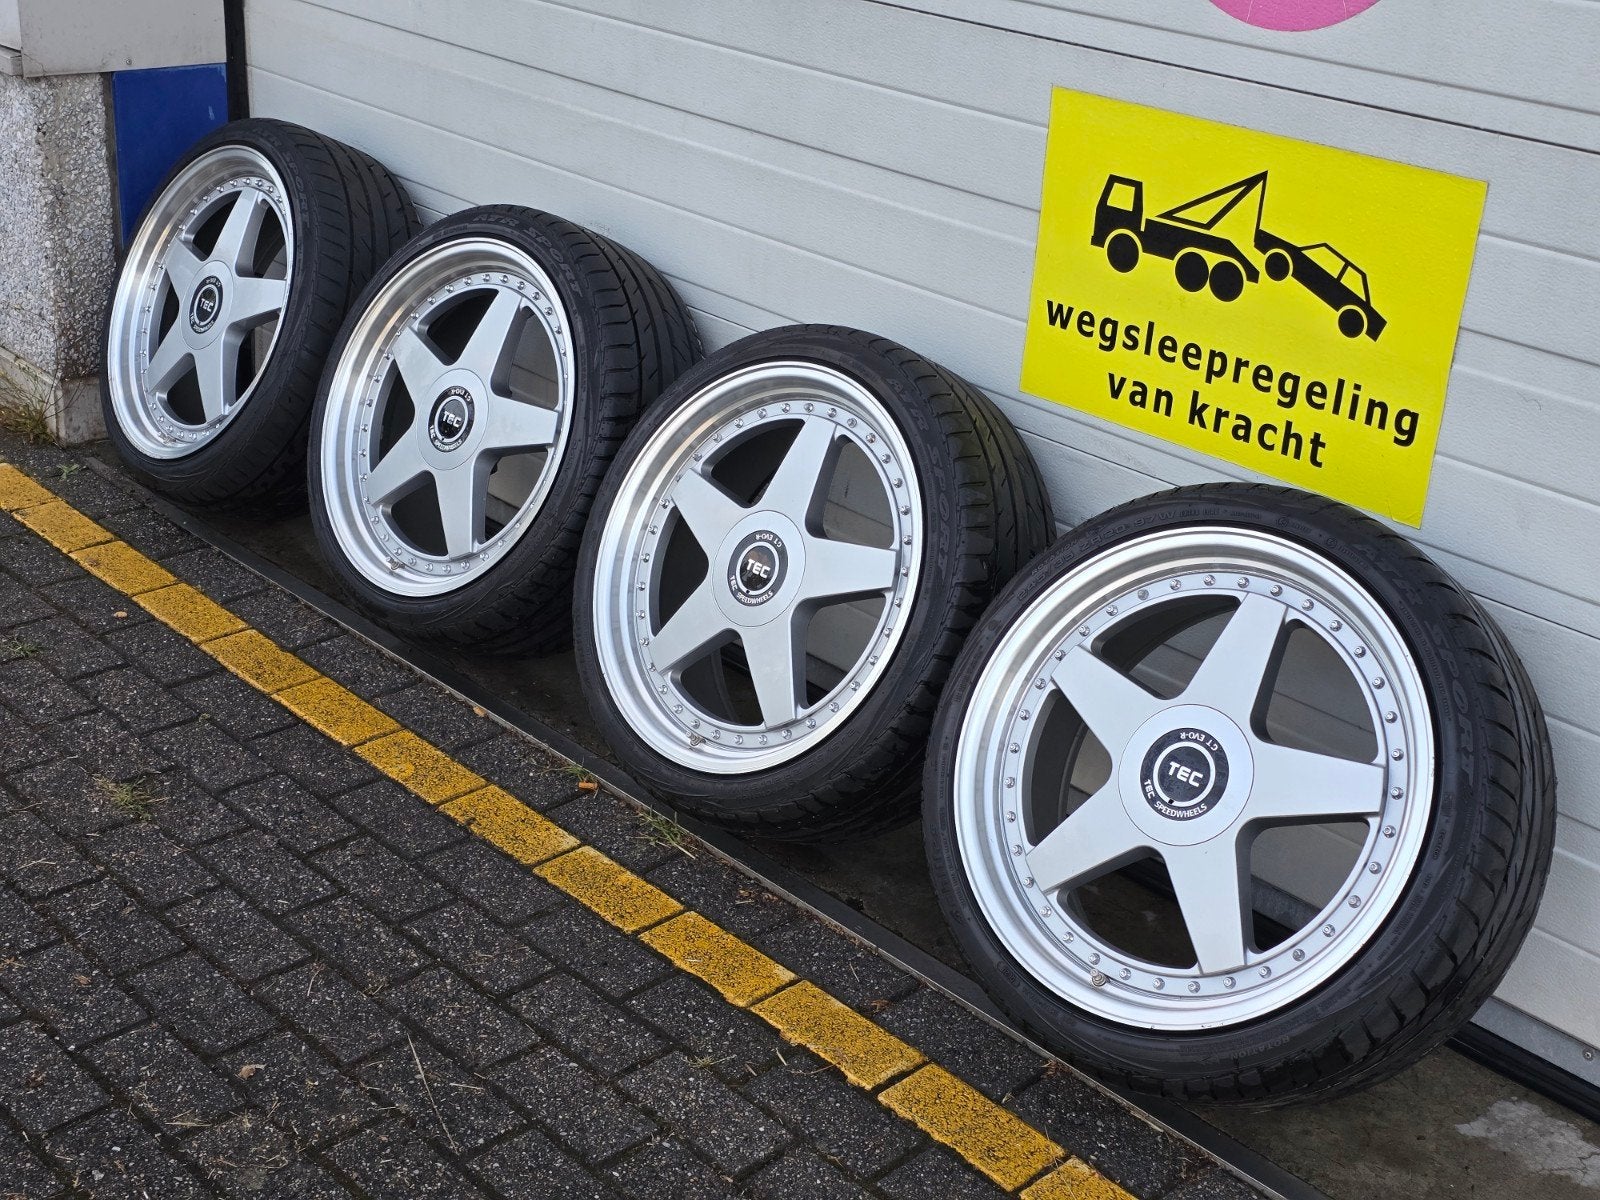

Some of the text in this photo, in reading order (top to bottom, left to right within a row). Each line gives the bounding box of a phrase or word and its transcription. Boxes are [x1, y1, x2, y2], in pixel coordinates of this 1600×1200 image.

[472, 213, 584, 298] ATR SPORT
[200, 298, 214, 312] TEC
[1046, 299, 1420, 447] wegsleepregeling
[442, 410, 462, 428] TEC
[1108, 372, 1327, 469] van kracht
[888, 377, 951, 580] ATR SPORT
[729, 574, 738, 592] TEC
[746, 558, 771, 579] TEC
[1427, 620, 1474, 785] SPORT
[1180, 731, 1219, 751] GT EVO-R
[1168, 761, 1204, 788] TEC
[1144, 778, 1208, 818] TEC SPEEDWHEELS
